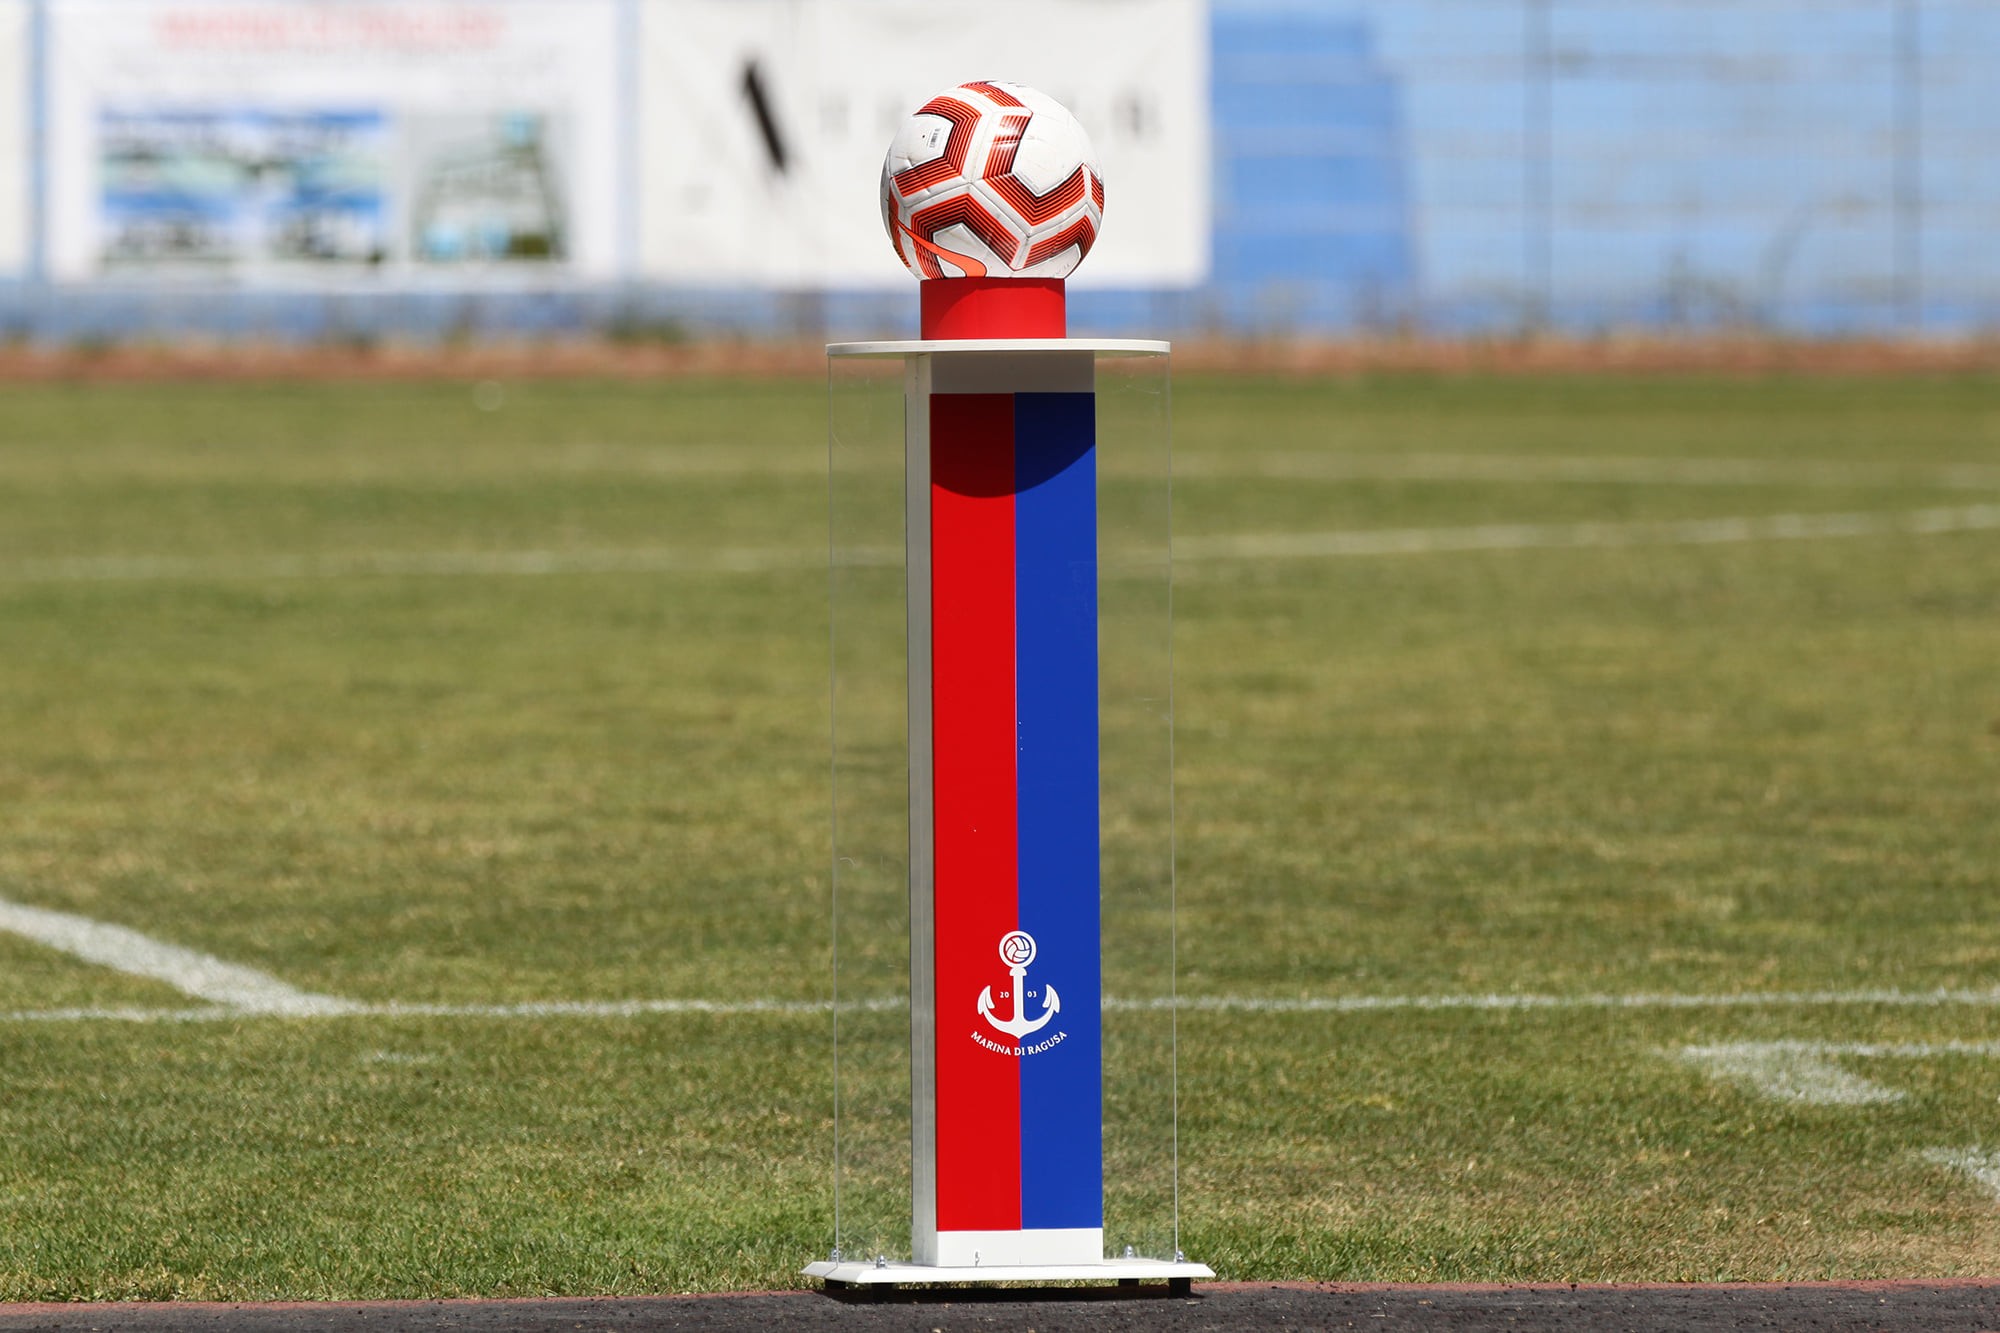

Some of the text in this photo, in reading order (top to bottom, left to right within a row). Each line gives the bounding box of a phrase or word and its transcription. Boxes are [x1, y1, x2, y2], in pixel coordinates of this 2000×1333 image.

[971, 1031, 1068, 1056] MARINA DI RAGUSA
